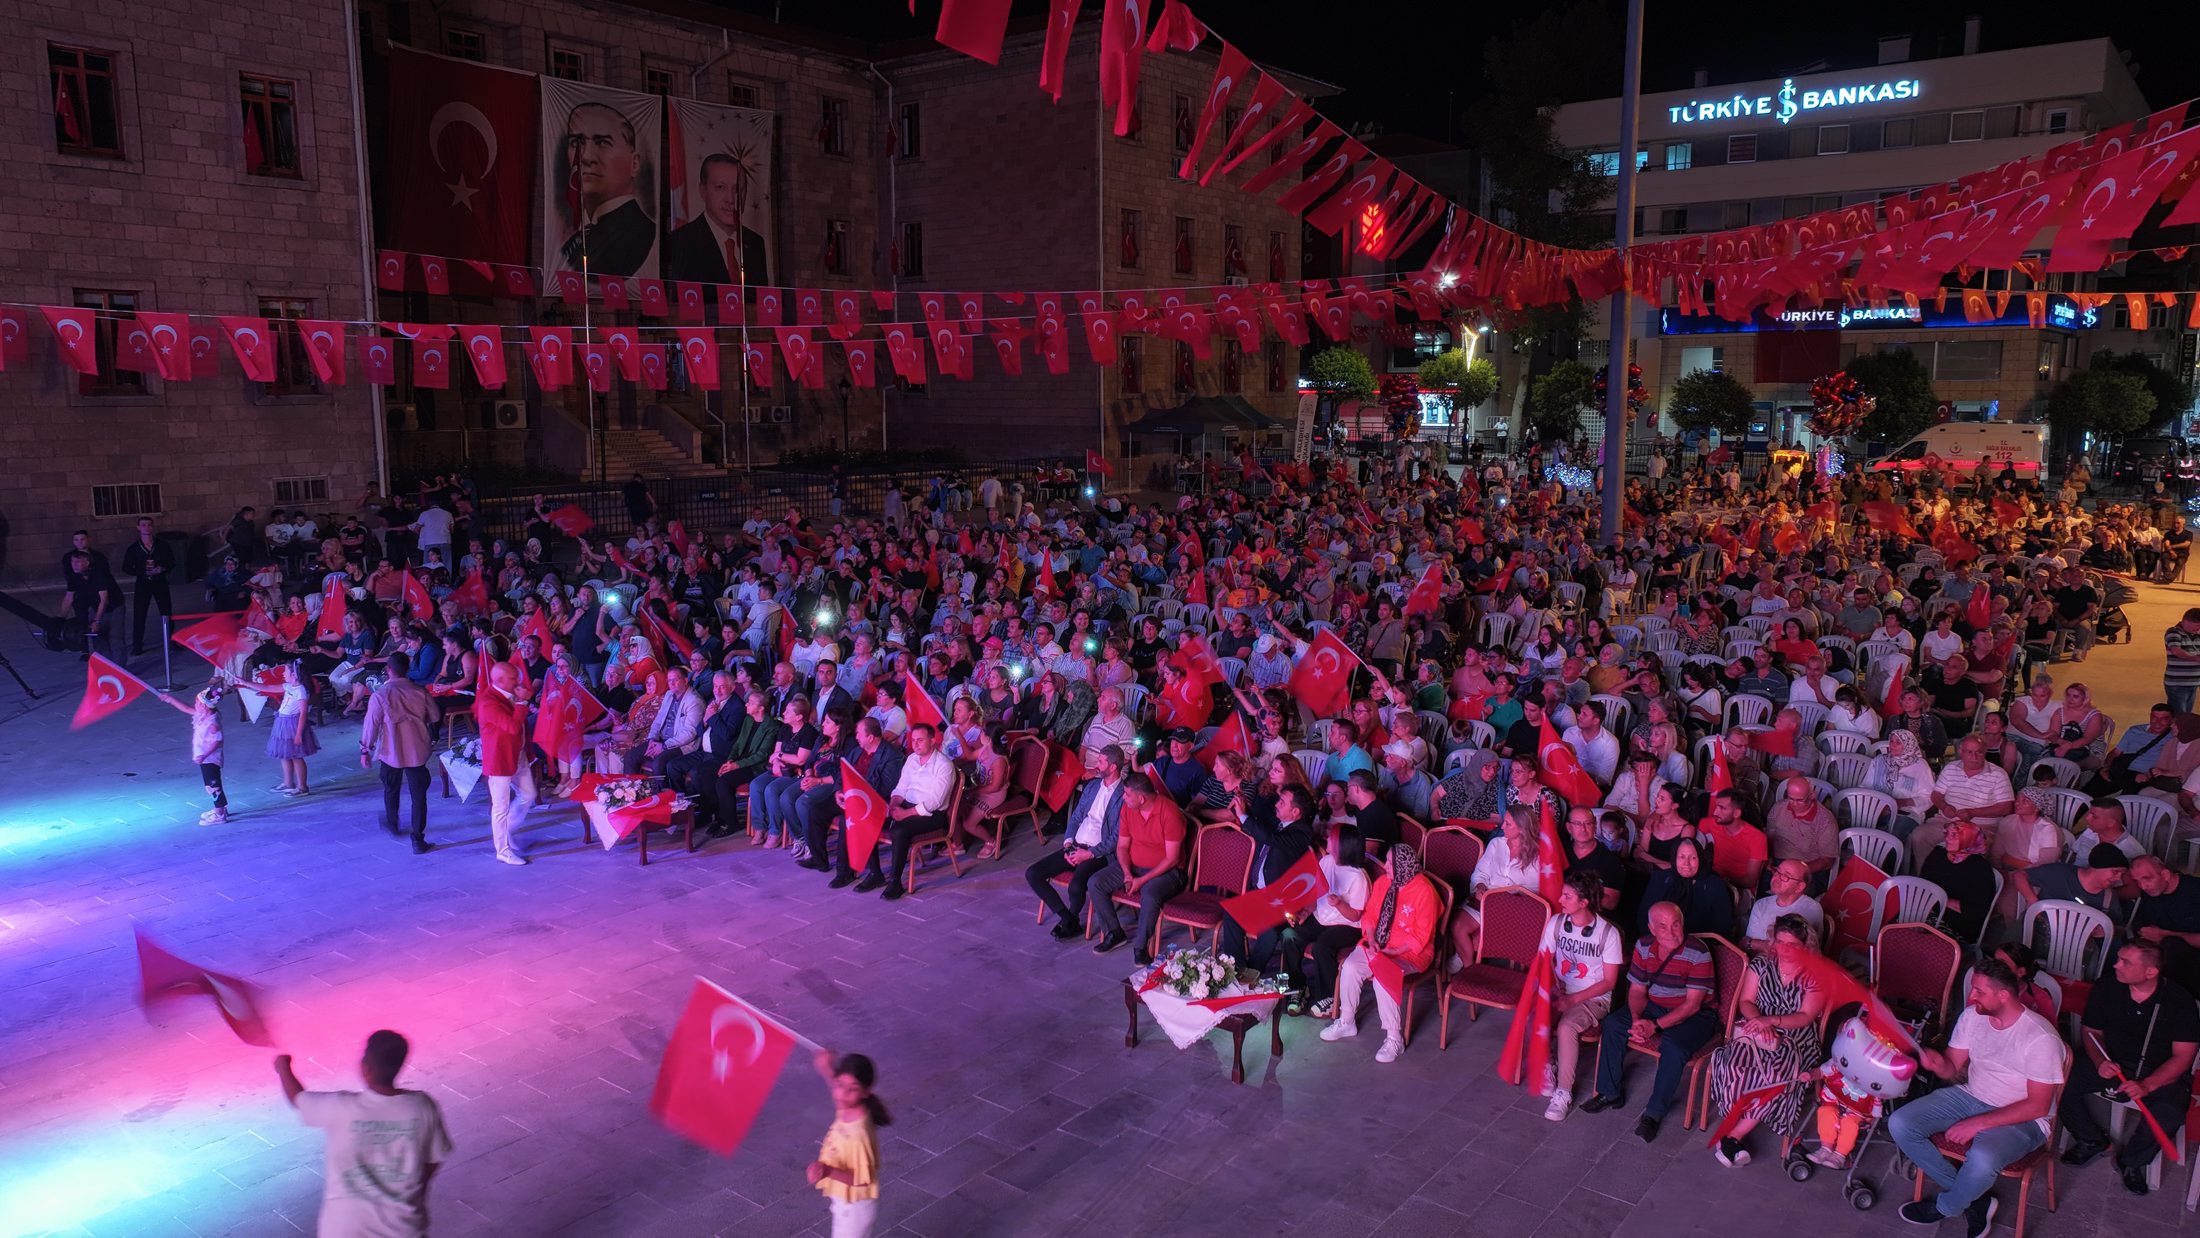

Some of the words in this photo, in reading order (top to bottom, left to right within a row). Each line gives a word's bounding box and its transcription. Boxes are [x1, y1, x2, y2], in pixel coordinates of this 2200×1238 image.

[1669, 95, 1771, 123] TÜRKİYE
[1803, 79, 1919, 110] BANKASI
[1776, 308, 1835, 322] ÜRKİYE
[1995, 451, 2013, 459] 112
